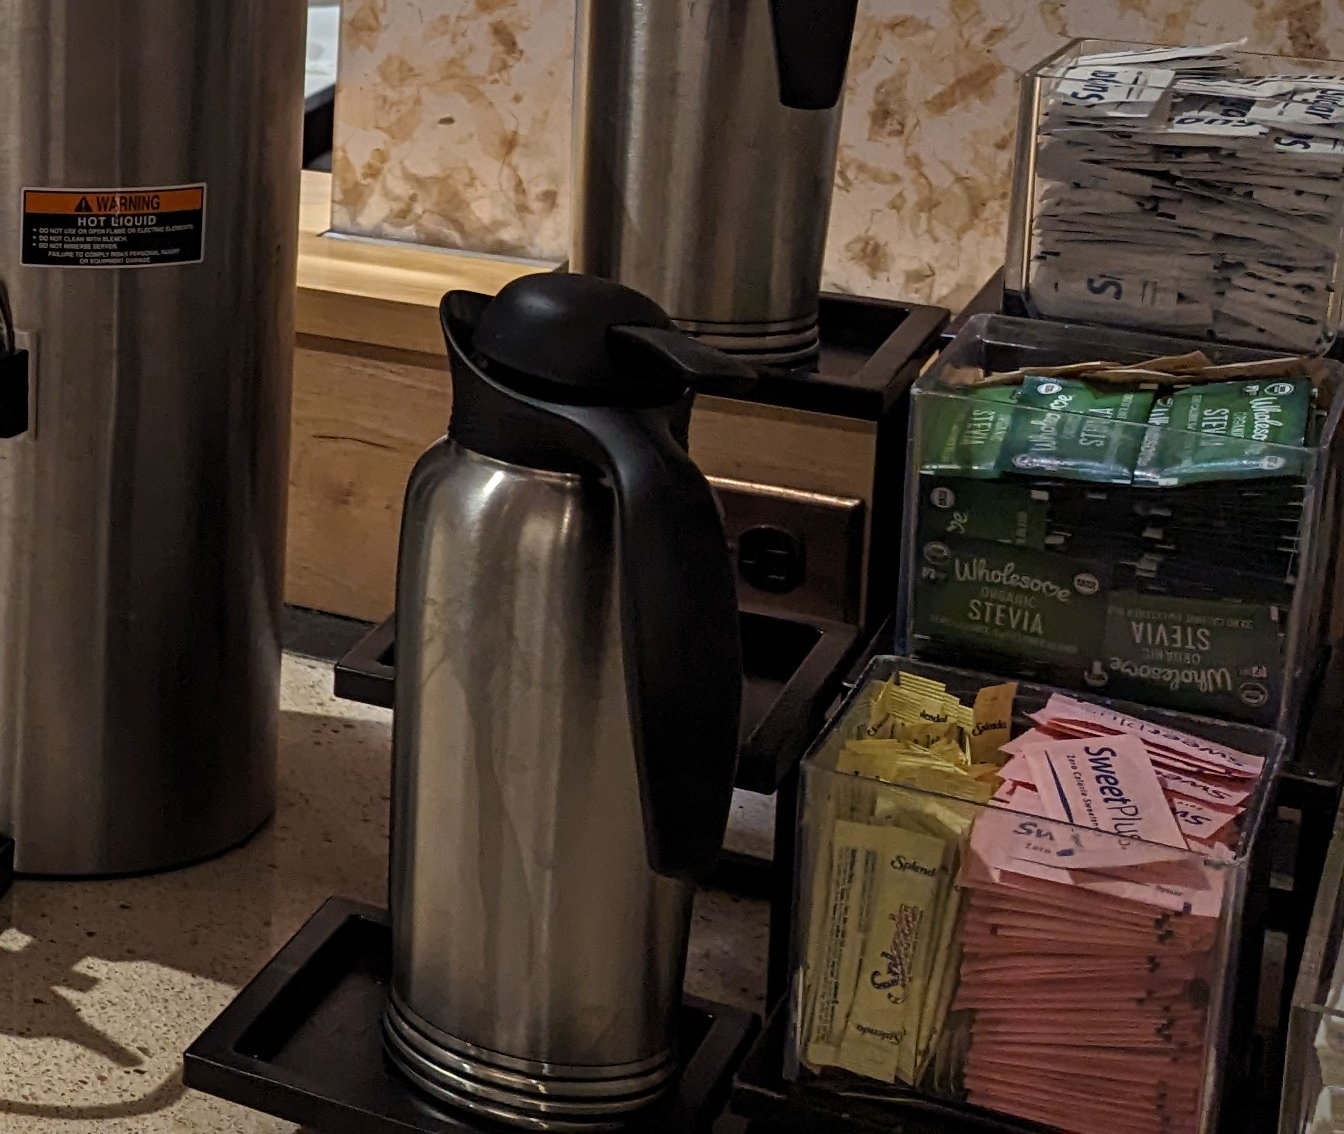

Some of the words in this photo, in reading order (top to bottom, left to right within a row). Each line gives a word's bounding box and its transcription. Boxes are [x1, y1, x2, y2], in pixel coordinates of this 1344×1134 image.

[96, 195, 161, 212] WARNING
[77, 217, 105, 227] HOT
[111, 216, 157, 227] LIQUID
[1249, 396, 1284, 446] Wholeso
[954, 556, 1072, 603] Wholesome
[968, 598, 1044, 635] STEVIA
[1131, 620, 1210, 651] STEVIA
[1111, 657, 1233, 694] Wholesome
[1082, 798, 1099, 833] Sweeten
[891, 855, 938, 877] Splend
